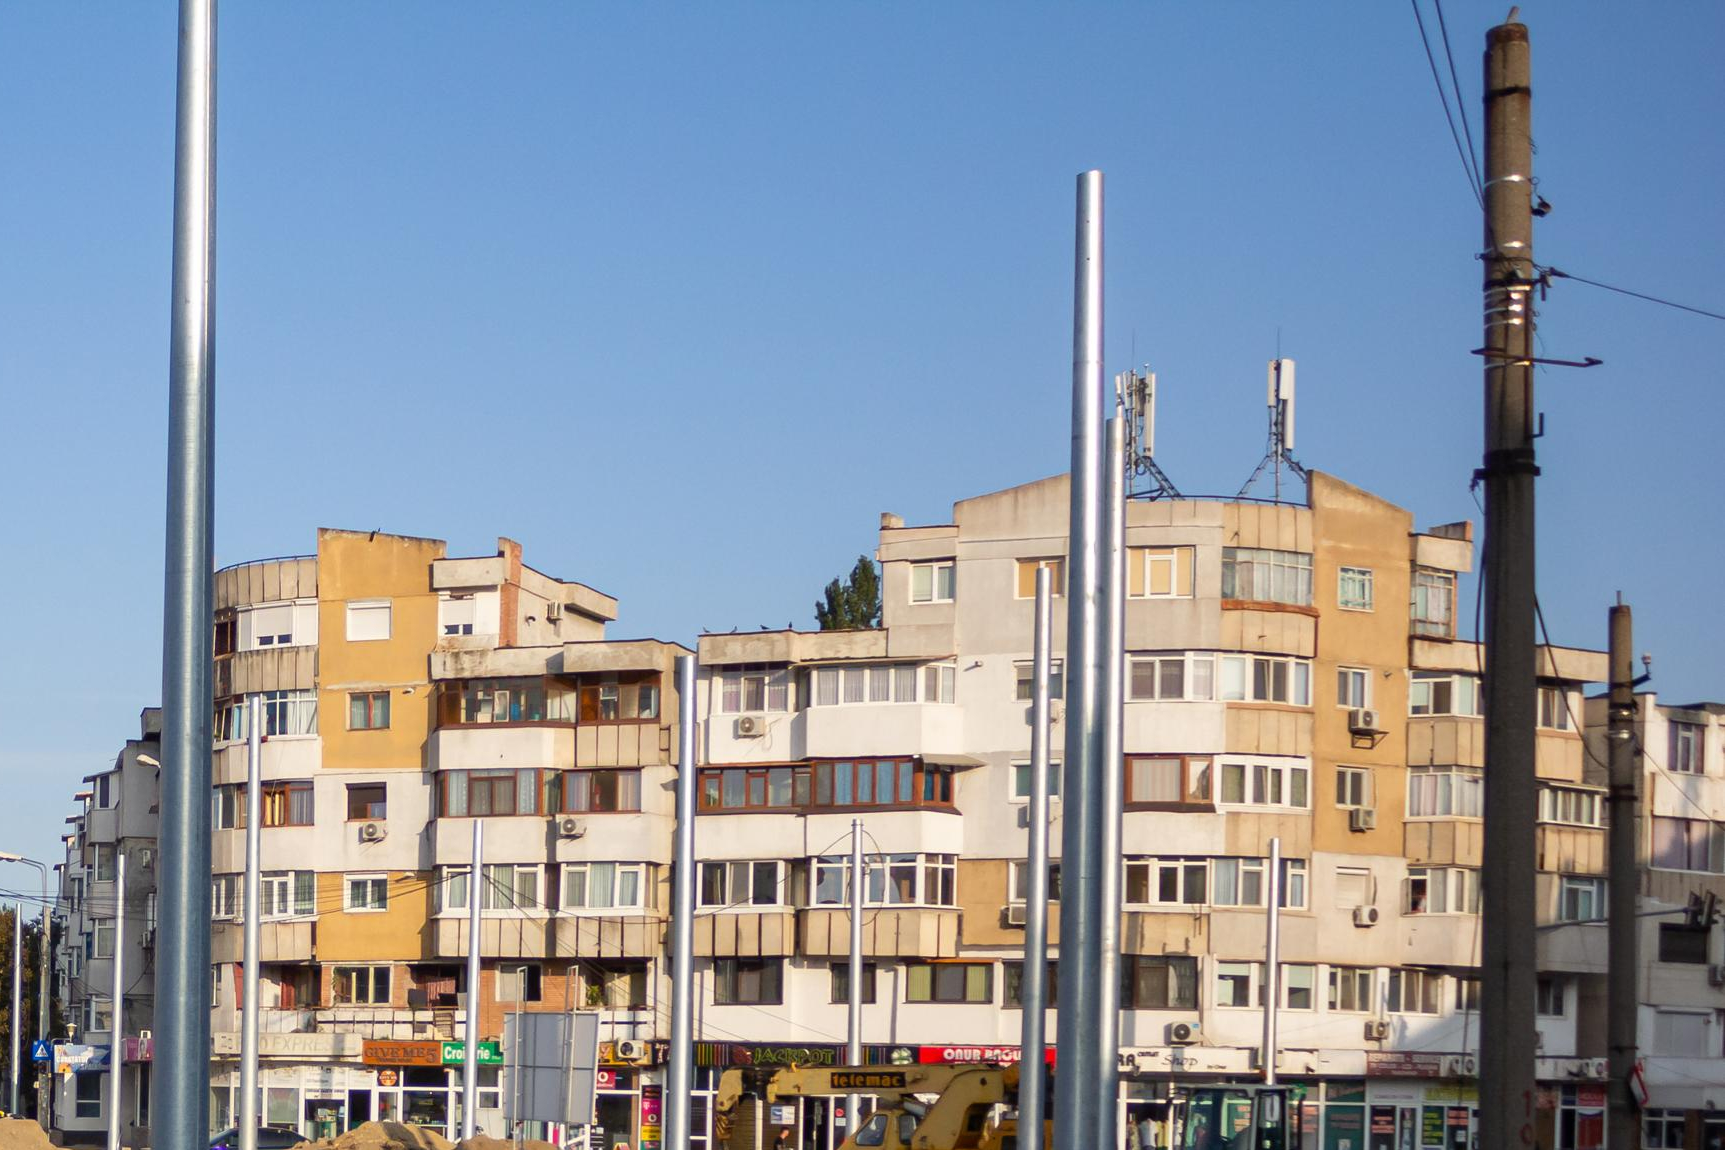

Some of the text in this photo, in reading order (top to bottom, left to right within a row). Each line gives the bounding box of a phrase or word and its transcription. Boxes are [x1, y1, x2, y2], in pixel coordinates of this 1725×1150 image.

[402, 1046, 425, 1058] ME
[444, 1046, 491, 1060] Croirie
[754, 1046, 835, 1065] JACKPOT
[832, 1072, 901, 1088] telemac
